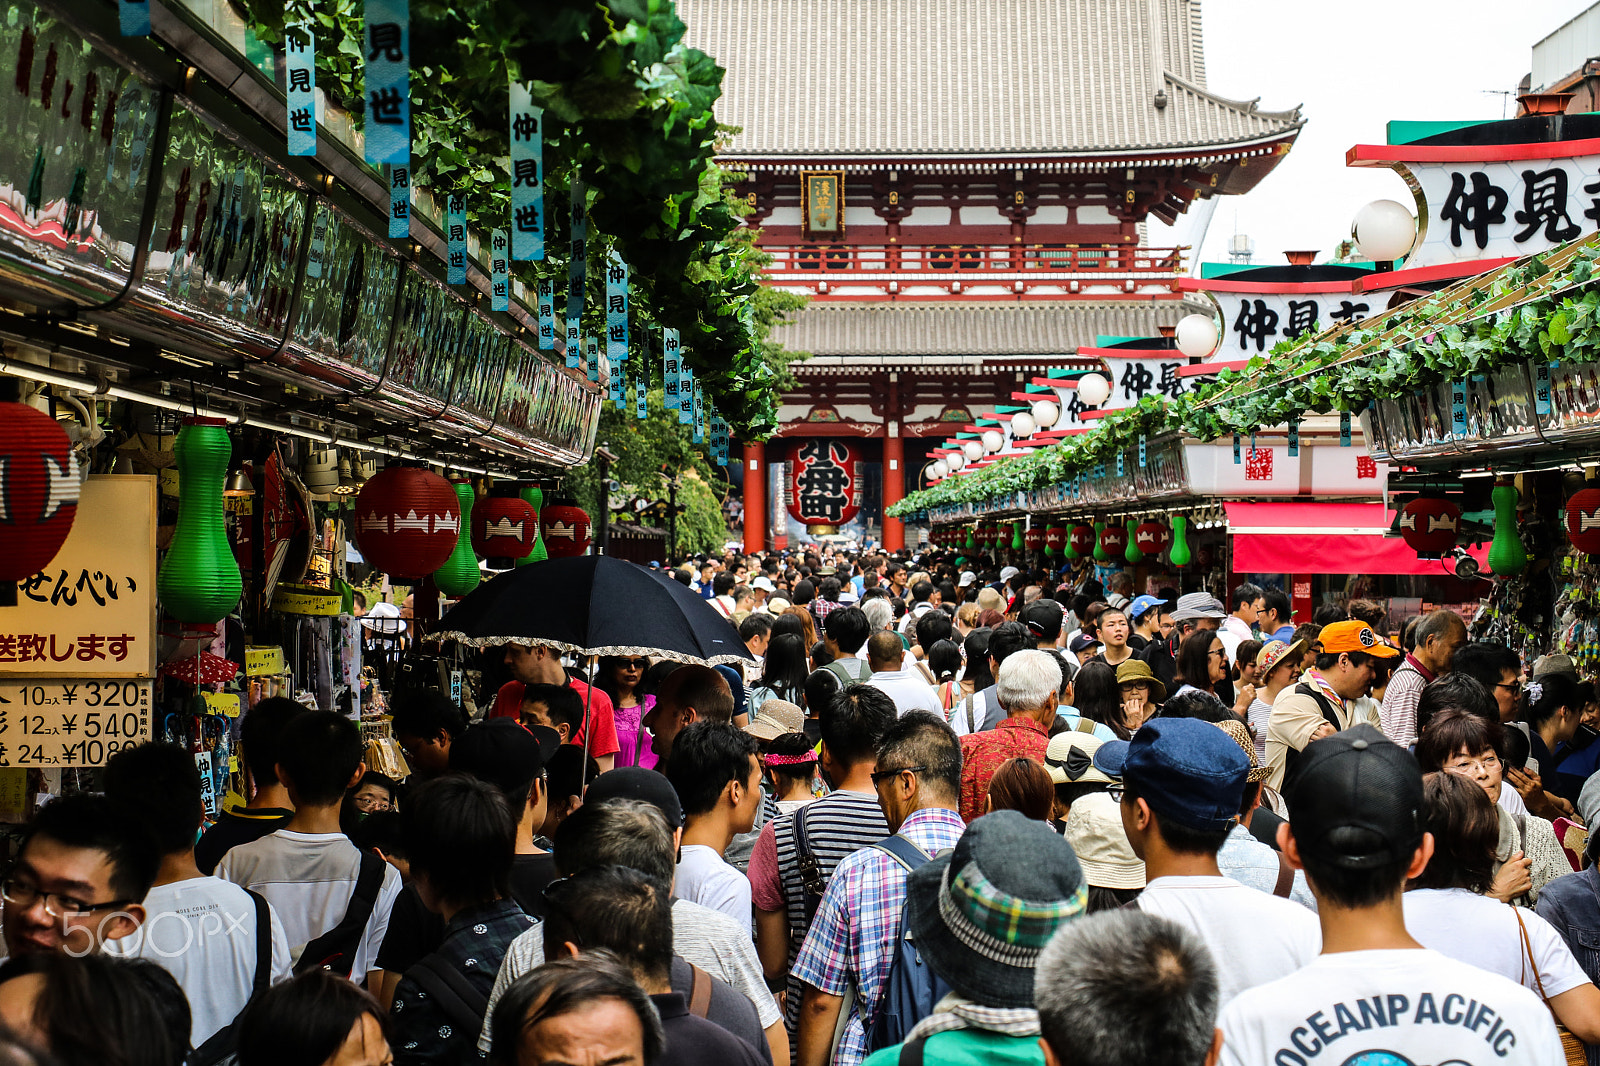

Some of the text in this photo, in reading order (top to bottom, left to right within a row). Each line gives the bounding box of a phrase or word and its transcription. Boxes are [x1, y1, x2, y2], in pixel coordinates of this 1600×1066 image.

[513, 112, 539, 232] 仲見世
[449, 198, 464, 268] 仲見世
[1440, 168, 1600, 249] 仲見
[493, 235, 506, 297] 仲見世
[540, 280, 552, 338] 仲見世
[608, 266, 625, 342] 仲見世
[666, 338, 679, 396] 仲見世
[797, 440, 851, 521] 小舟町
[18, 568, 137, 607] せんべい
[198, 759, 212, 812] 仲見世
